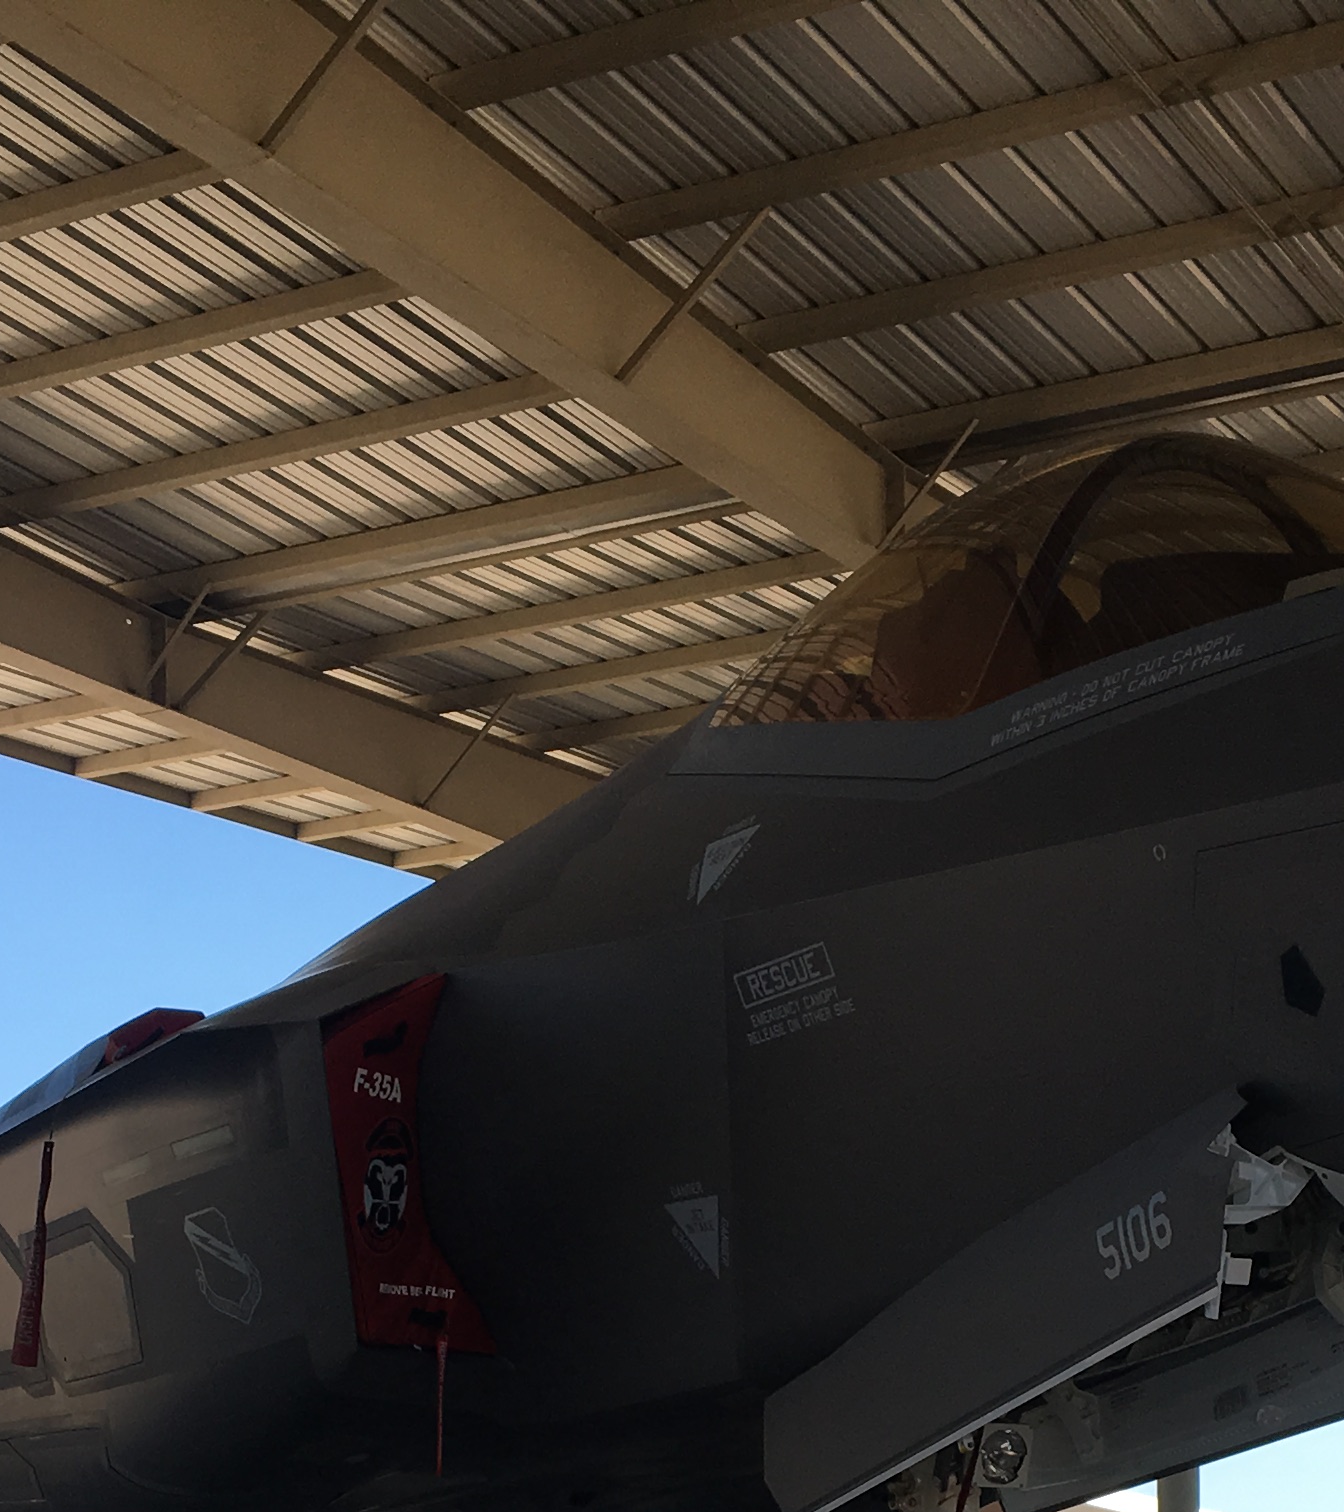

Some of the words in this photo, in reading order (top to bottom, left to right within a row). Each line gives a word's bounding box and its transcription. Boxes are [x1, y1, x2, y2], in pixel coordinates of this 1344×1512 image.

[990, 722, 1031, 747] WITHIN
[1035, 715, 1047, 729] 3
[1049, 694, 1099, 723] INCHES
[1103, 684, 1122, 703] OF
[1127, 662, 1188, 694] CANOPY
[1190, 643, 1246, 672] FRAME
[1011, 692, 1068, 724] WARNING
[1082, 679, 1099, 696] DO
[1103, 668, 1131, 688] NOT
[1135, 656, 1166, 676] CUT
[1171, 632, 1237, 664] CANOPY
[746, 951, 822, 1000] RESCUE
[746, 1022, 788, 1047] RELEASE
[787, 1017, 803, 1033] ON
[801, 1006, 835, 1028] OTHER
[833, 996, 856, 1017] SIDE
[750, 1000, 801, 1029] EMERGENCY
[802, 986, 840, 1010] CANOPY
[353, 1066, 402, 1104] F-35A
[1095, 1190, 1173, 1280] 5106
